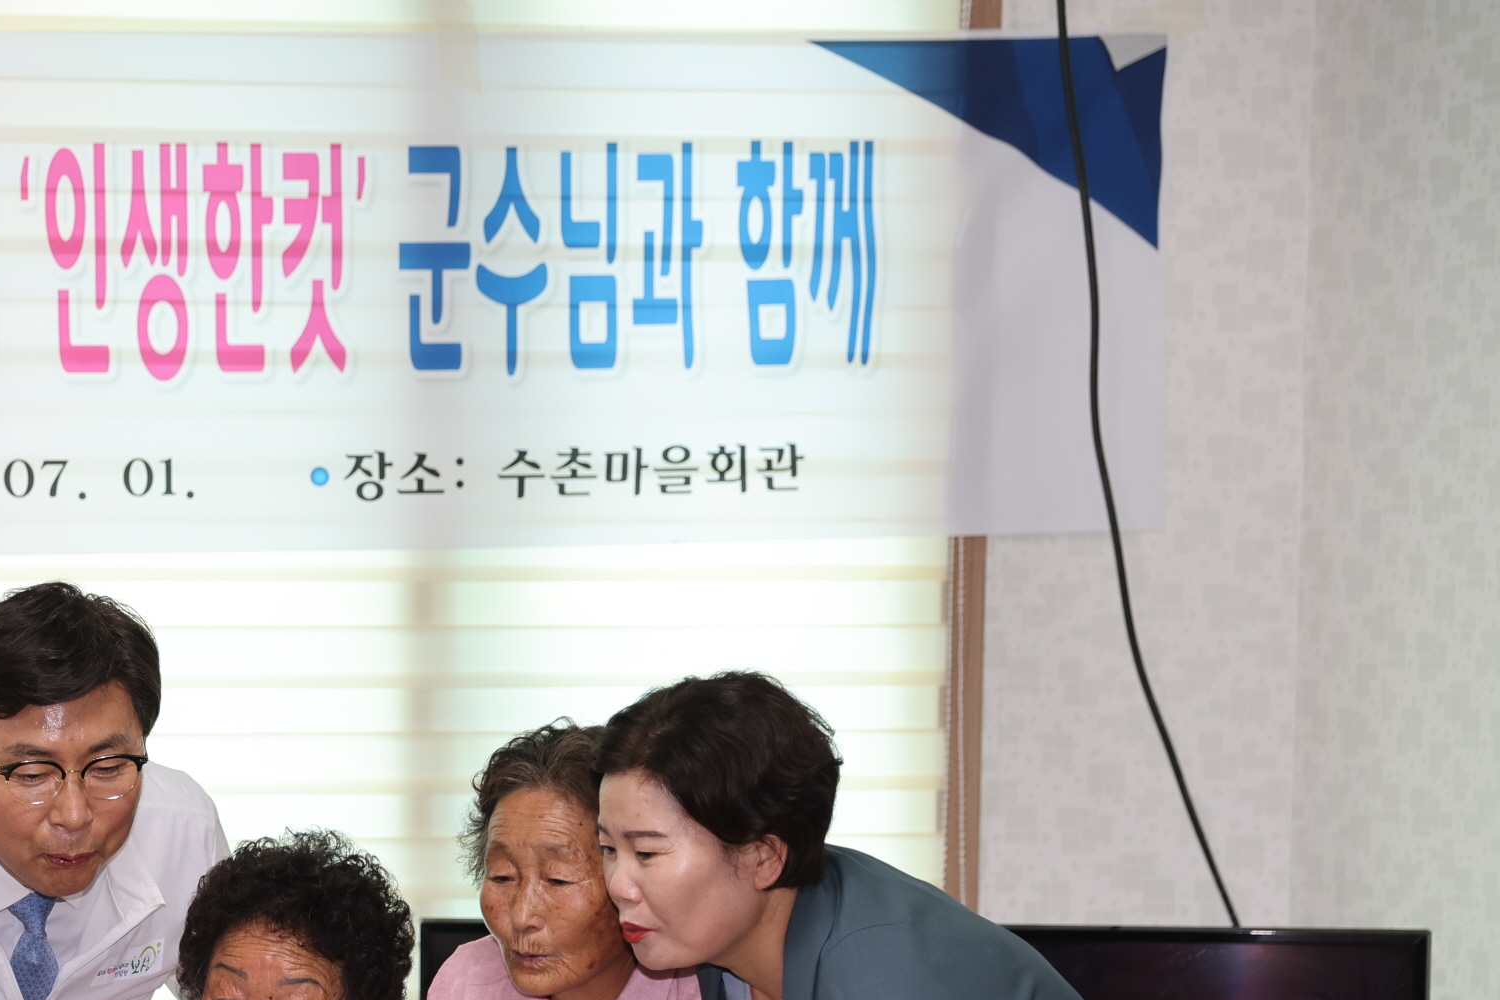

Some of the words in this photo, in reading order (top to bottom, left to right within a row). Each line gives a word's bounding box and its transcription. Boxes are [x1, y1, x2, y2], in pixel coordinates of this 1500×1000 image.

[398, 141, 704, 376] 군수님과
[736, 140, 878, 367] 함께
[3, 459, 88, 500] 07.
[122, 458, 197, 499] 01.
[343, 450, 467, 502] 장소:
[497, 443, 806, 500] 수촌마을회관
